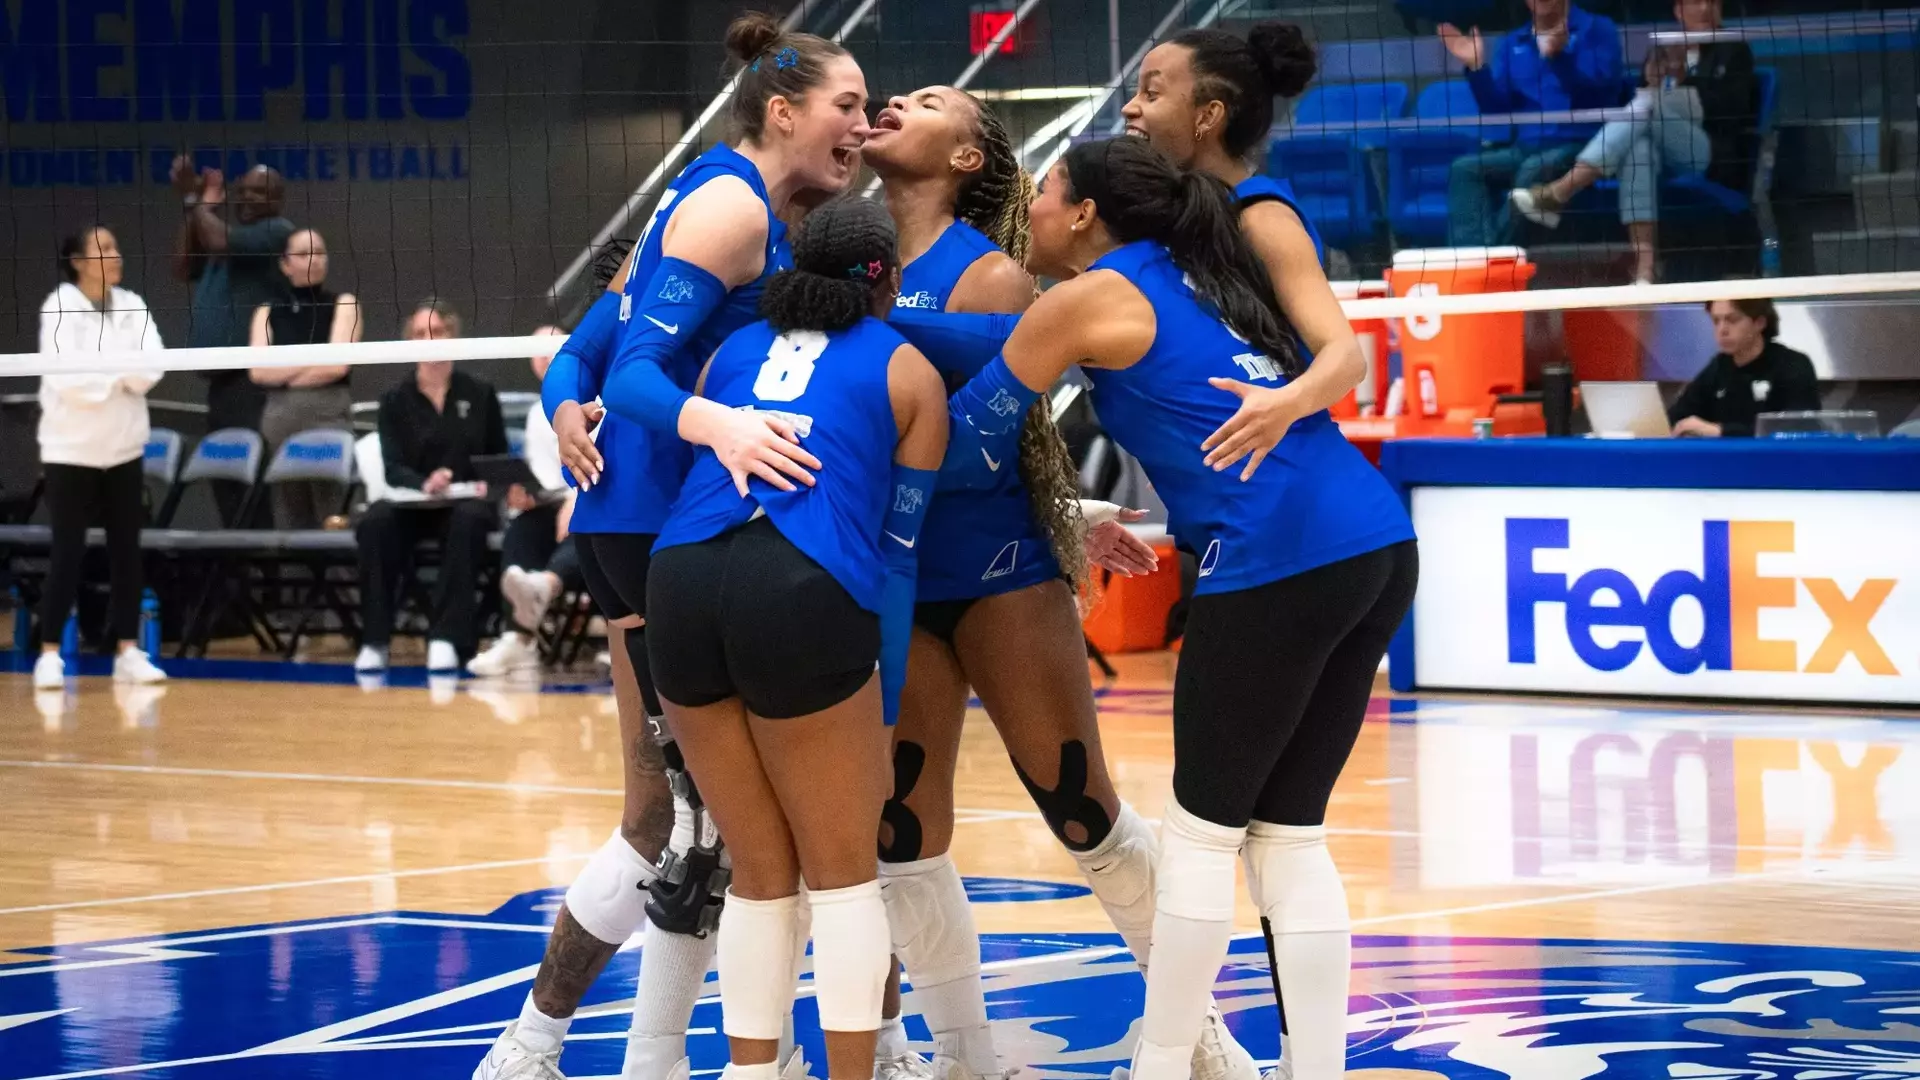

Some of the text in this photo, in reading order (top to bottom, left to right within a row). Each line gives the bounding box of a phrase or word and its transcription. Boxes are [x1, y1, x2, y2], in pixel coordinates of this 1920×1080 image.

[0, 0, 471, 123] MEMPHIS
[896, 291, 938, 310] edEx
[752, 328, 830, 402] 8
[1505, 517, 1901, 676] FedEx
